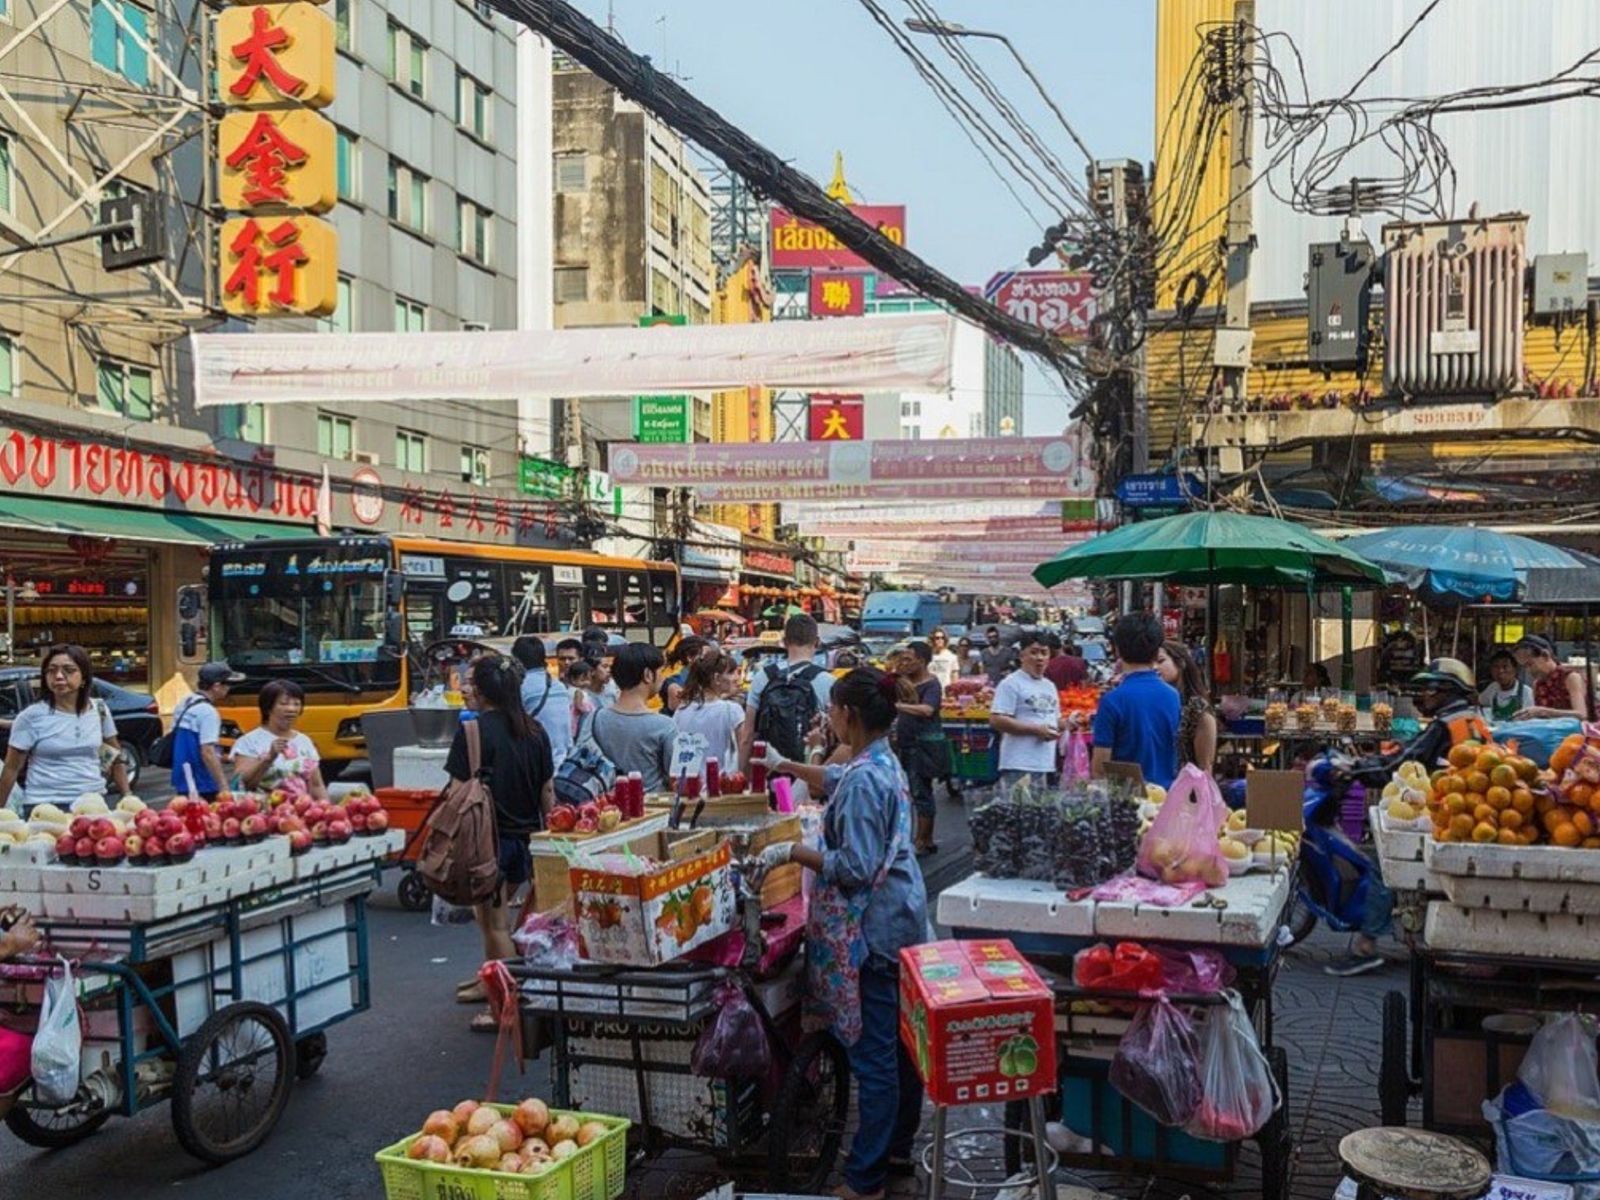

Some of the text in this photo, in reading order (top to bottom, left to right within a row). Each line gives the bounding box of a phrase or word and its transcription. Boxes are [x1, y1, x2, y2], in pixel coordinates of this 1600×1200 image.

[225, 7, 309, 306] 大金行
[821, 409, 850, 439] 大
[88, 870, 101, 890] S
